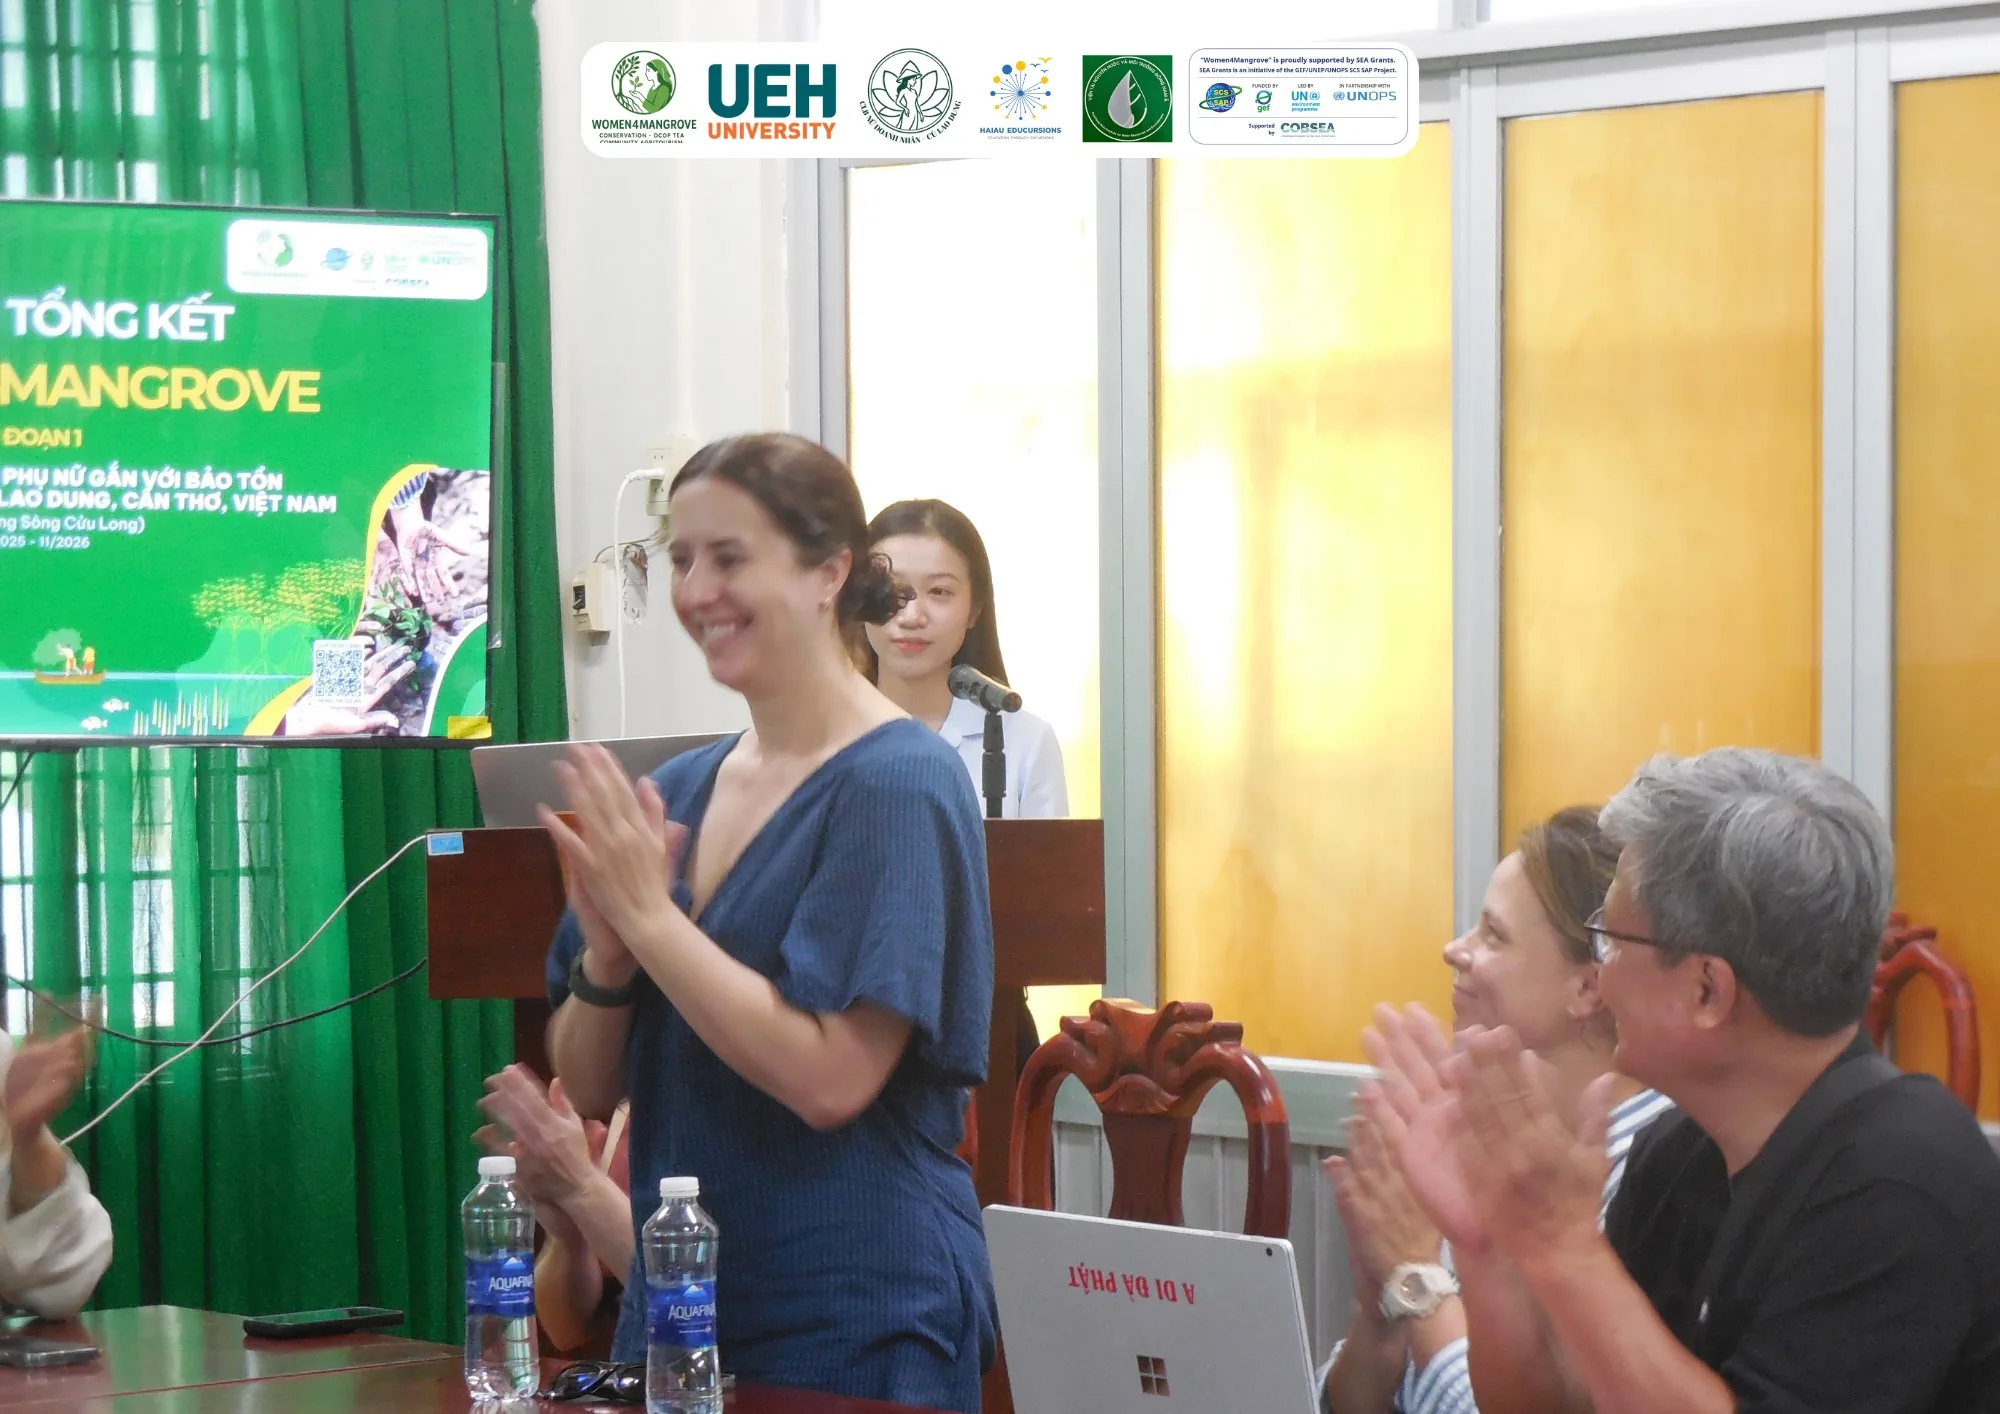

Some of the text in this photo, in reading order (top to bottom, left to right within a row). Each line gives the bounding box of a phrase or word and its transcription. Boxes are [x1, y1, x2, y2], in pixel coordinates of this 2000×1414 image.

[147, 292, 236, 341] KẾT
[0, 362, 321, 413] MANGROVE
[73, 428, 83, 447] 1
[53, 464, 87, 487] NỮ
[88, 461, 138, 487] GẮN
[142, 465, 181, 489] VỚI
[185, 465, 233, 490] BẢO
[46, 490, 118, 512] DUNG,
[173, 491, 228, 515] THƠ,
[232, 491, 283, 517] VIỆT
[286, 495, 337, 513] NAM
[20, 515, 61, 532] Sông
[99, 516, 146, 535] Long)
[1155, 1278, 1178, 1302] DI
[1181, 1282, 1195, 1305] A
